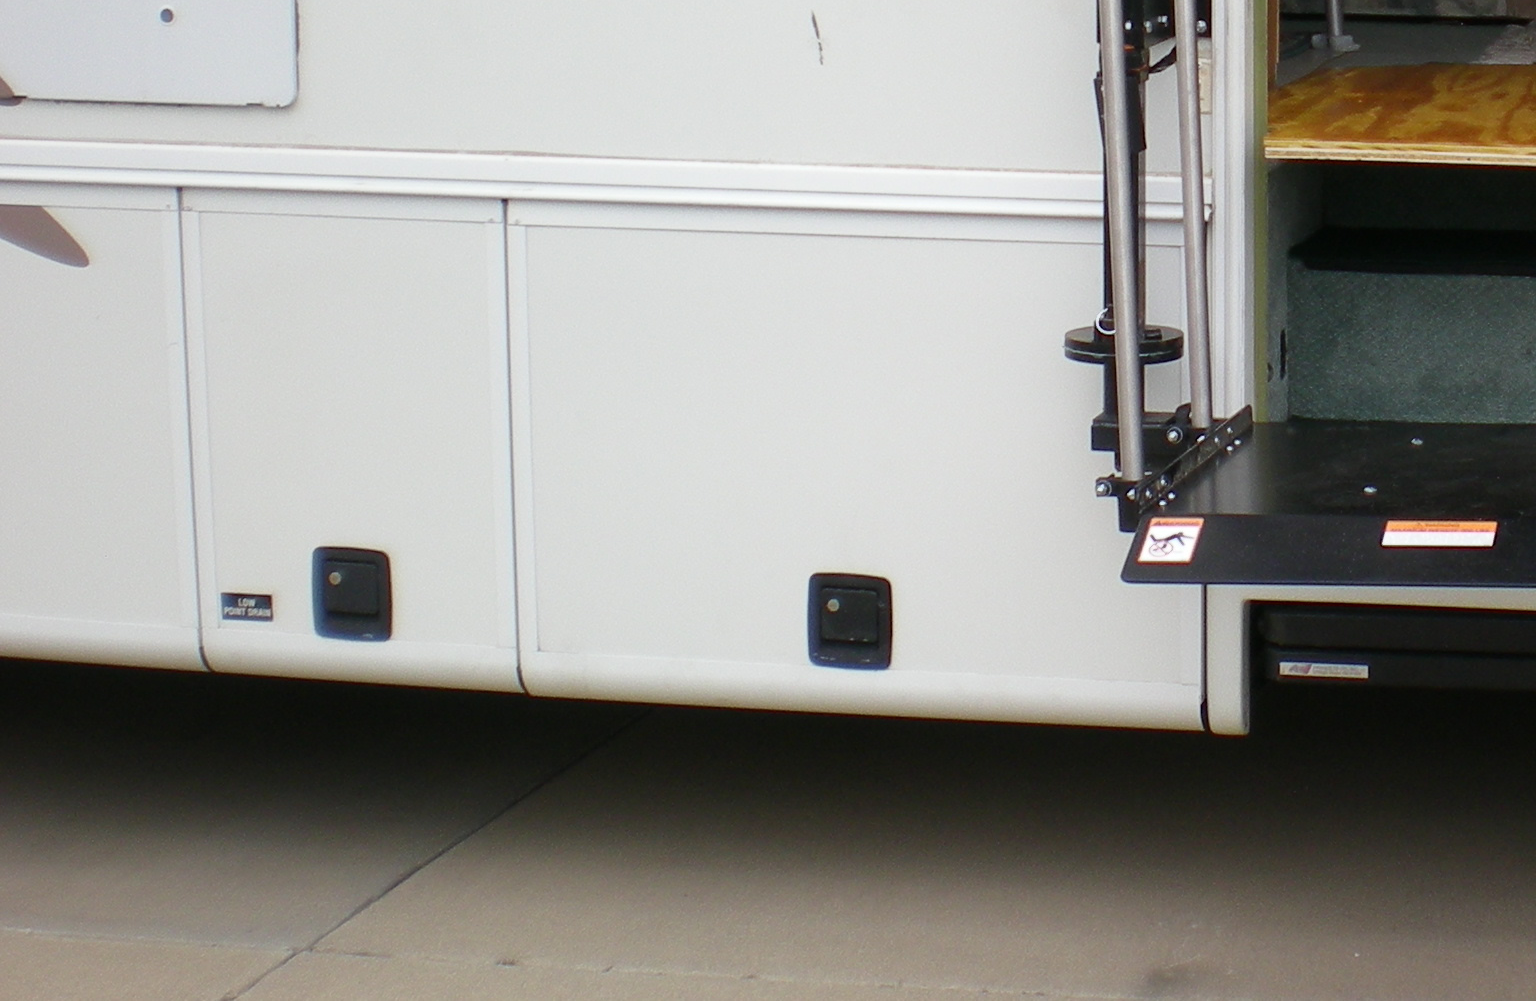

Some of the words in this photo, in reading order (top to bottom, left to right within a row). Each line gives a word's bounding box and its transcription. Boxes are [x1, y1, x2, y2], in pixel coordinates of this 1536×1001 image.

[238, 597, 256, 607] LOW
[224, 607, 246, 615] POINT
[248, 608, 271, 616] DRAIN
